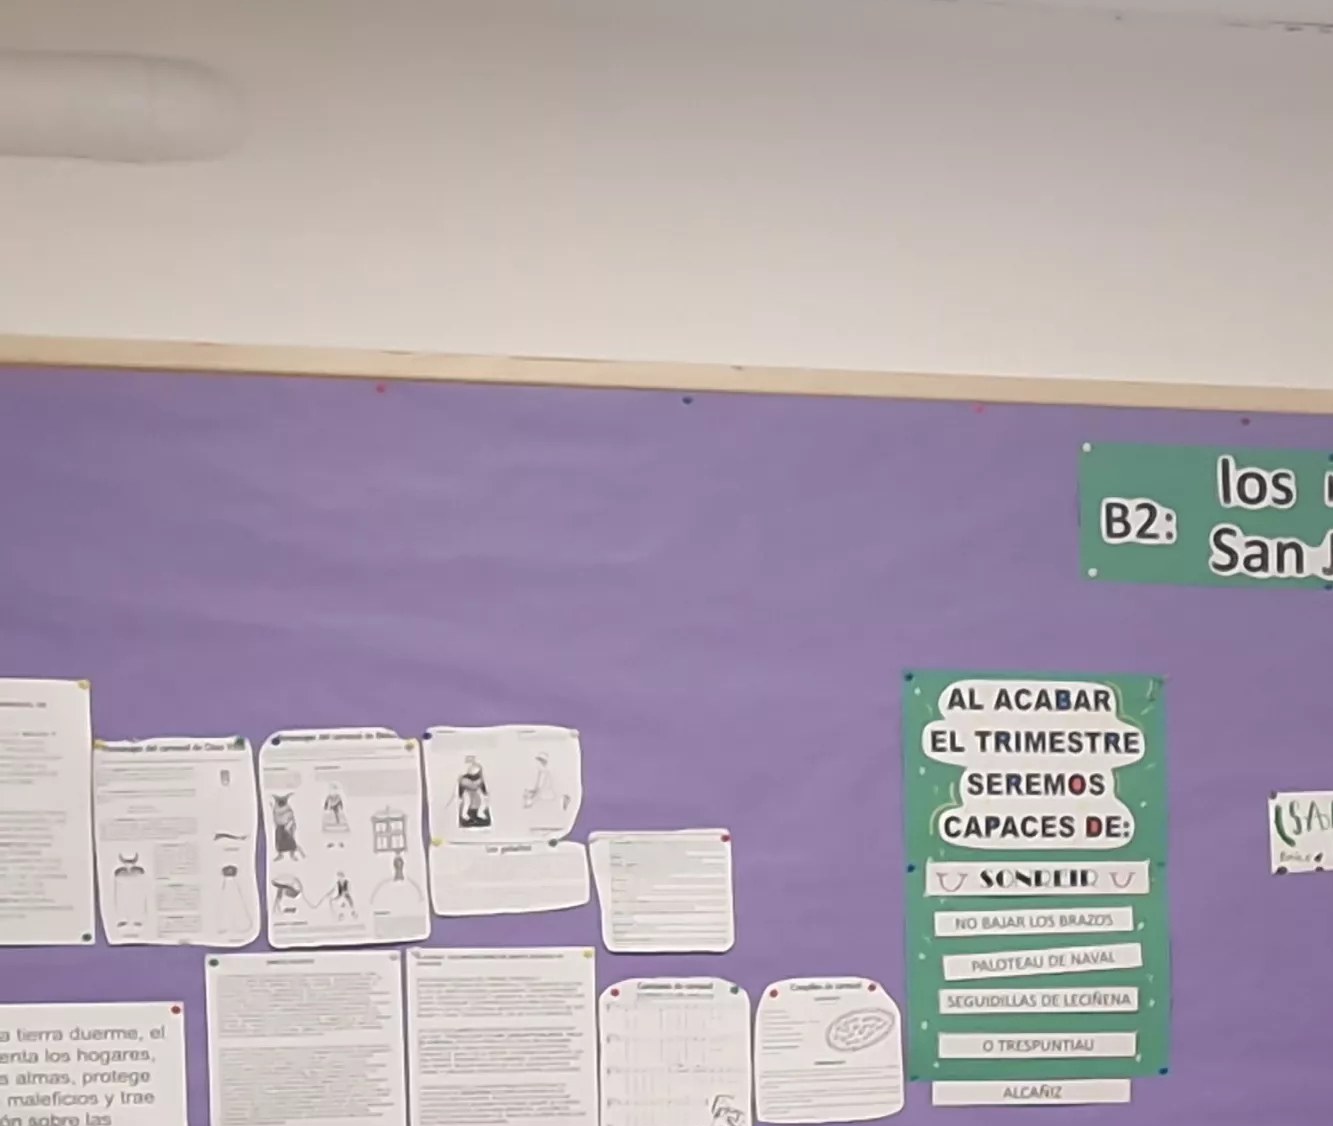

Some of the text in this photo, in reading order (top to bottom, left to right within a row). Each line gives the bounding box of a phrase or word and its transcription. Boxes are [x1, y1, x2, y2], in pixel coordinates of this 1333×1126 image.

[1216, 457, 1295, 507] los
[1103, 502, 1175, 540] B2:
[1209, 526, 1304, 575] San
[947, 689, 1112, 712] AL ACABAR
[930, 731, 1141, 754] EL TRIMESTRE
[966, 773, 1106, 796] SEREMOS
[943, 816, 1131, 838] CAPACES DE:
[955, 913, 1114, 931] NO BAJAR LOS BRAZOS
[971, 950, 1117, 973] PALOTEAU DE NAVAL
[947, 994, 1038, 1009] SEGUIDILLAS
[1041, 993, 1060, 1007] DE
[149, 1025, 166, 1041] el
[982, 1037, 1095, 1053] O TRESPUNTIAU
[44, 1048, 71, 1063] los
[104, 1094, 115, 1108] y
[120, 1092, 156, 1106] trae
[1002, 1082, 1063, 1099] ALCAÑIZ
[85, 1112, 112, 1126] las
